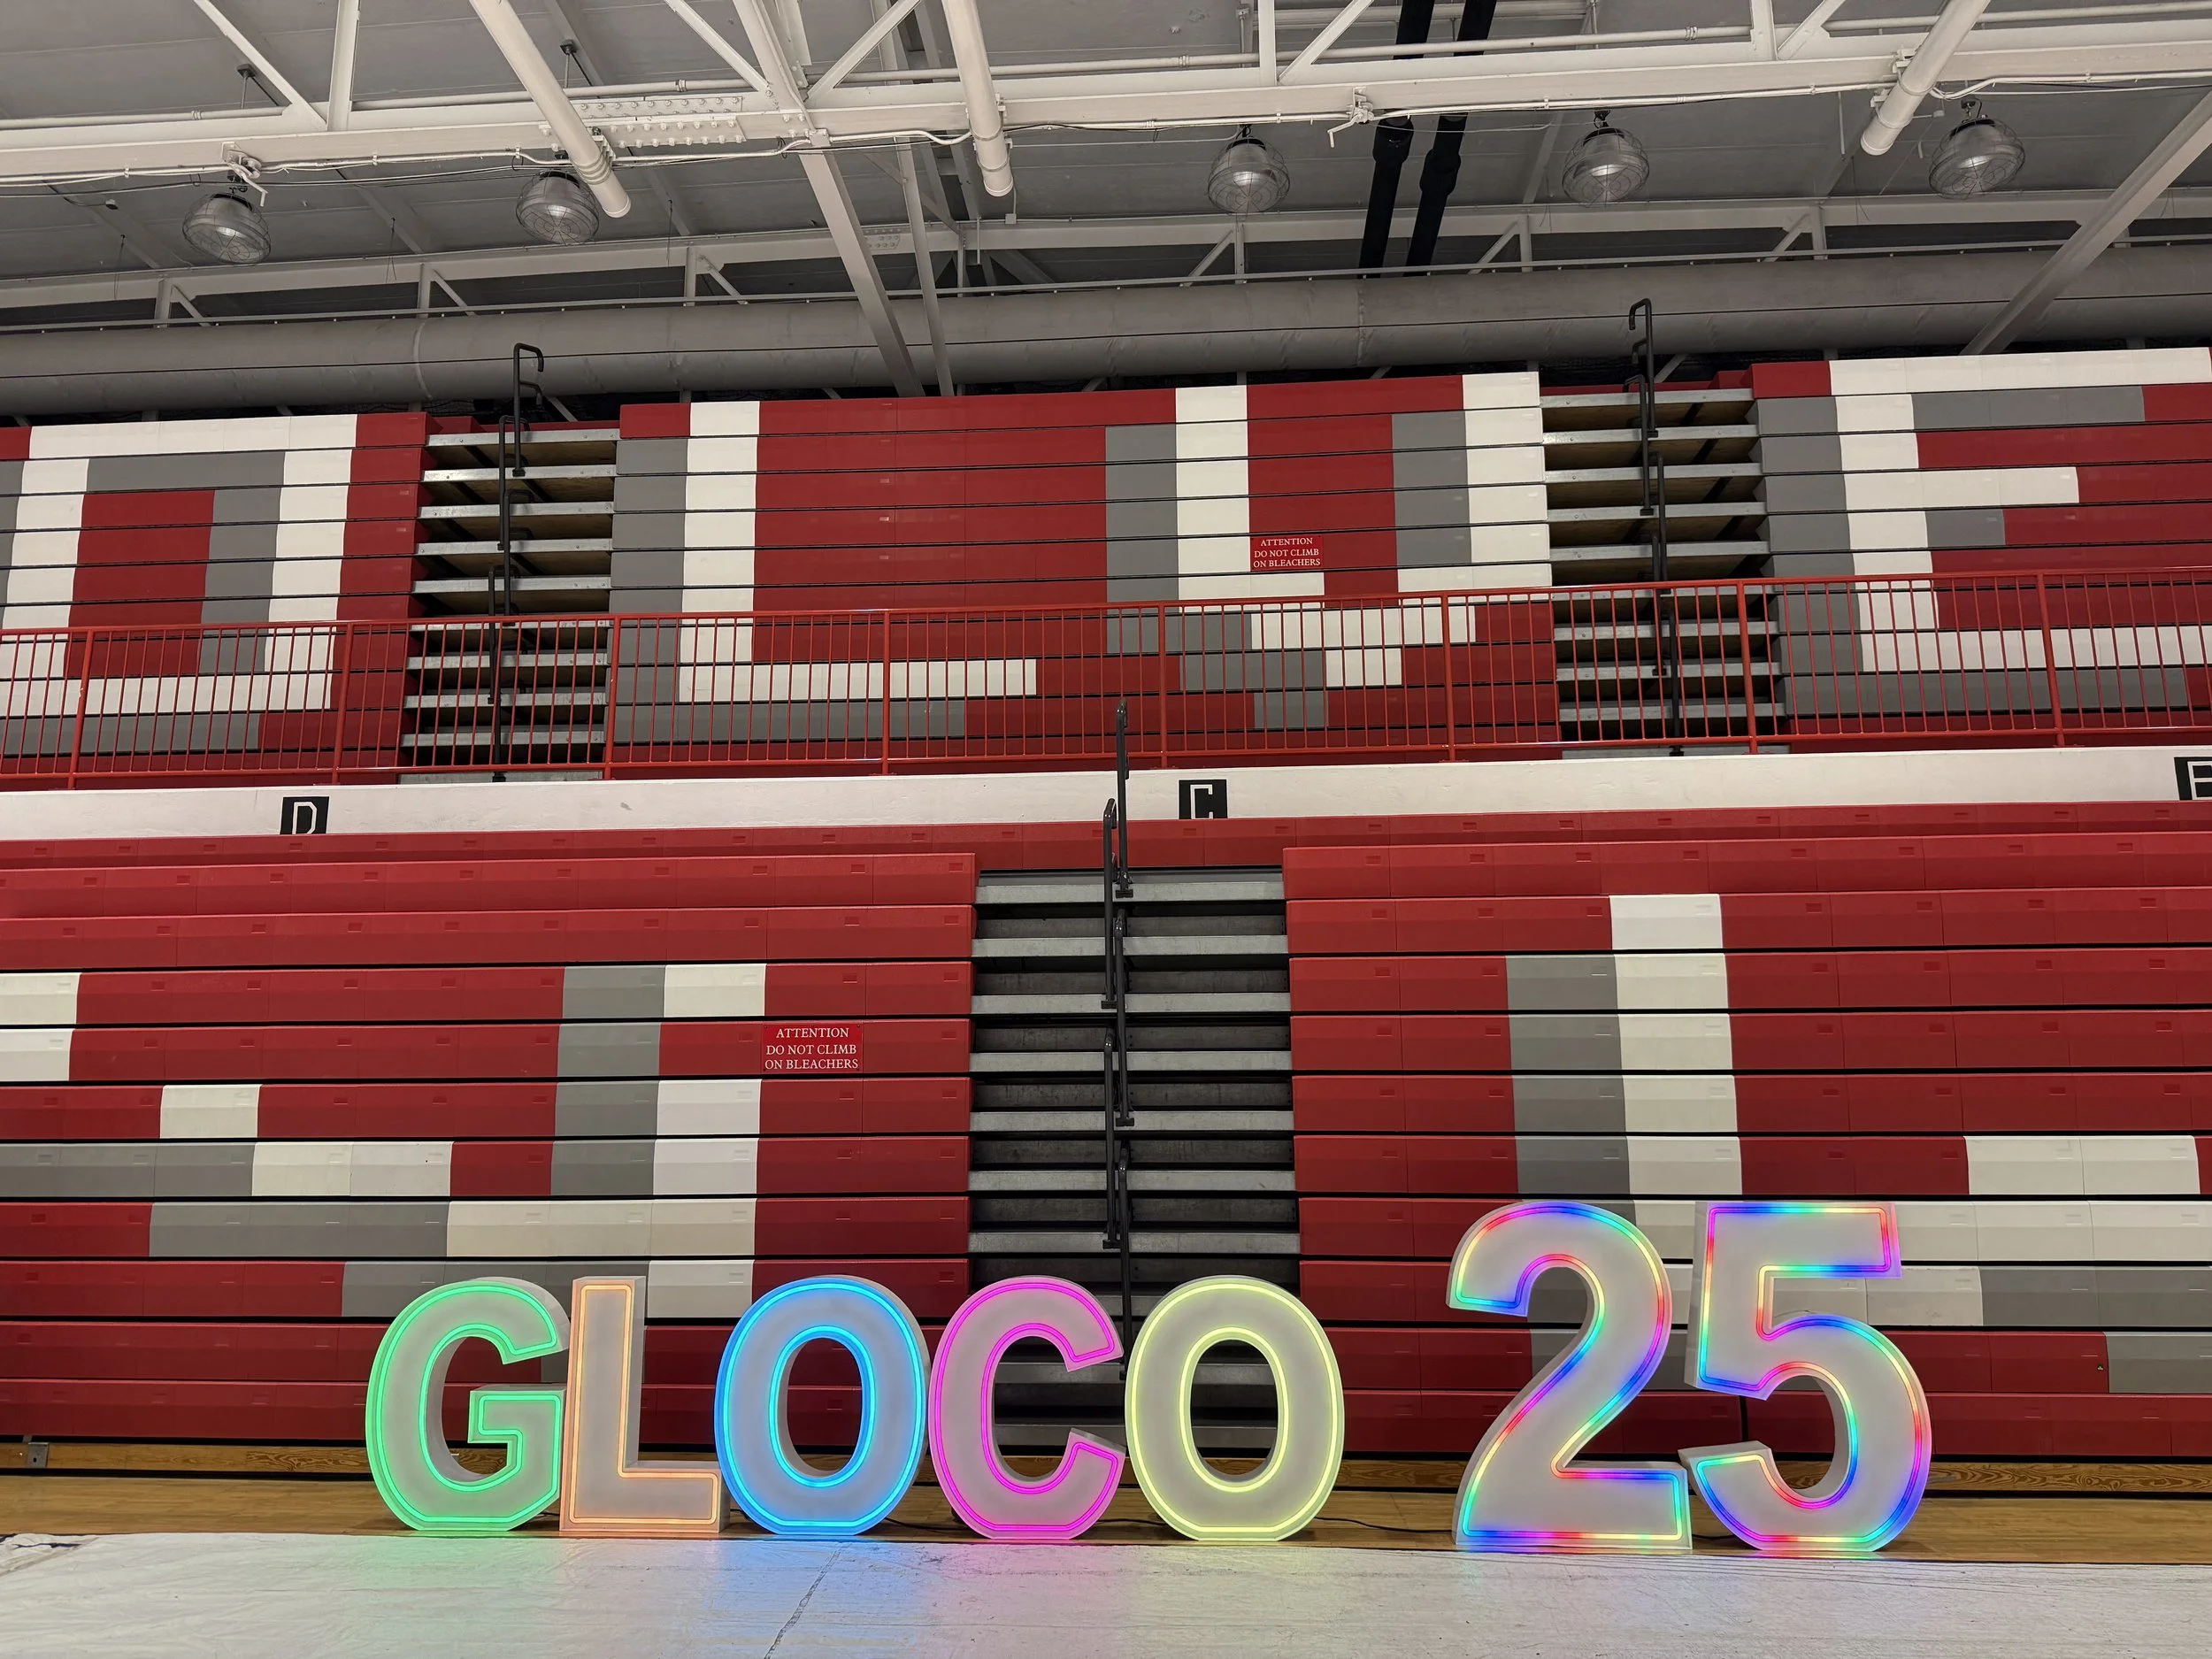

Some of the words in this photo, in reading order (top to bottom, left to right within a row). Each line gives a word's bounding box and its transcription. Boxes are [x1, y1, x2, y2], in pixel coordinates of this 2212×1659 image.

[1260, 537, 1313, 547] ATTENTION
[1290, 548, 1319, 557] CLIMB
[1269, 558, 1321, 567] BLEACHERS
[291, 802, 318, 835] D
[775, 1027, 849, 1039] ATTENTION
[765, 1045, 785, 1056] DO
[787, 1044, 815, 1055] NOT
[817, 1044, 857, 1055] CLIMB
[764, 1059, 783, 1070] ON
[786, 1058, 859, 1070] BLEACHERS
[365, 1275, 1345, 1541] GLOCO
[1446, 1201, 1932, 1553] 25
